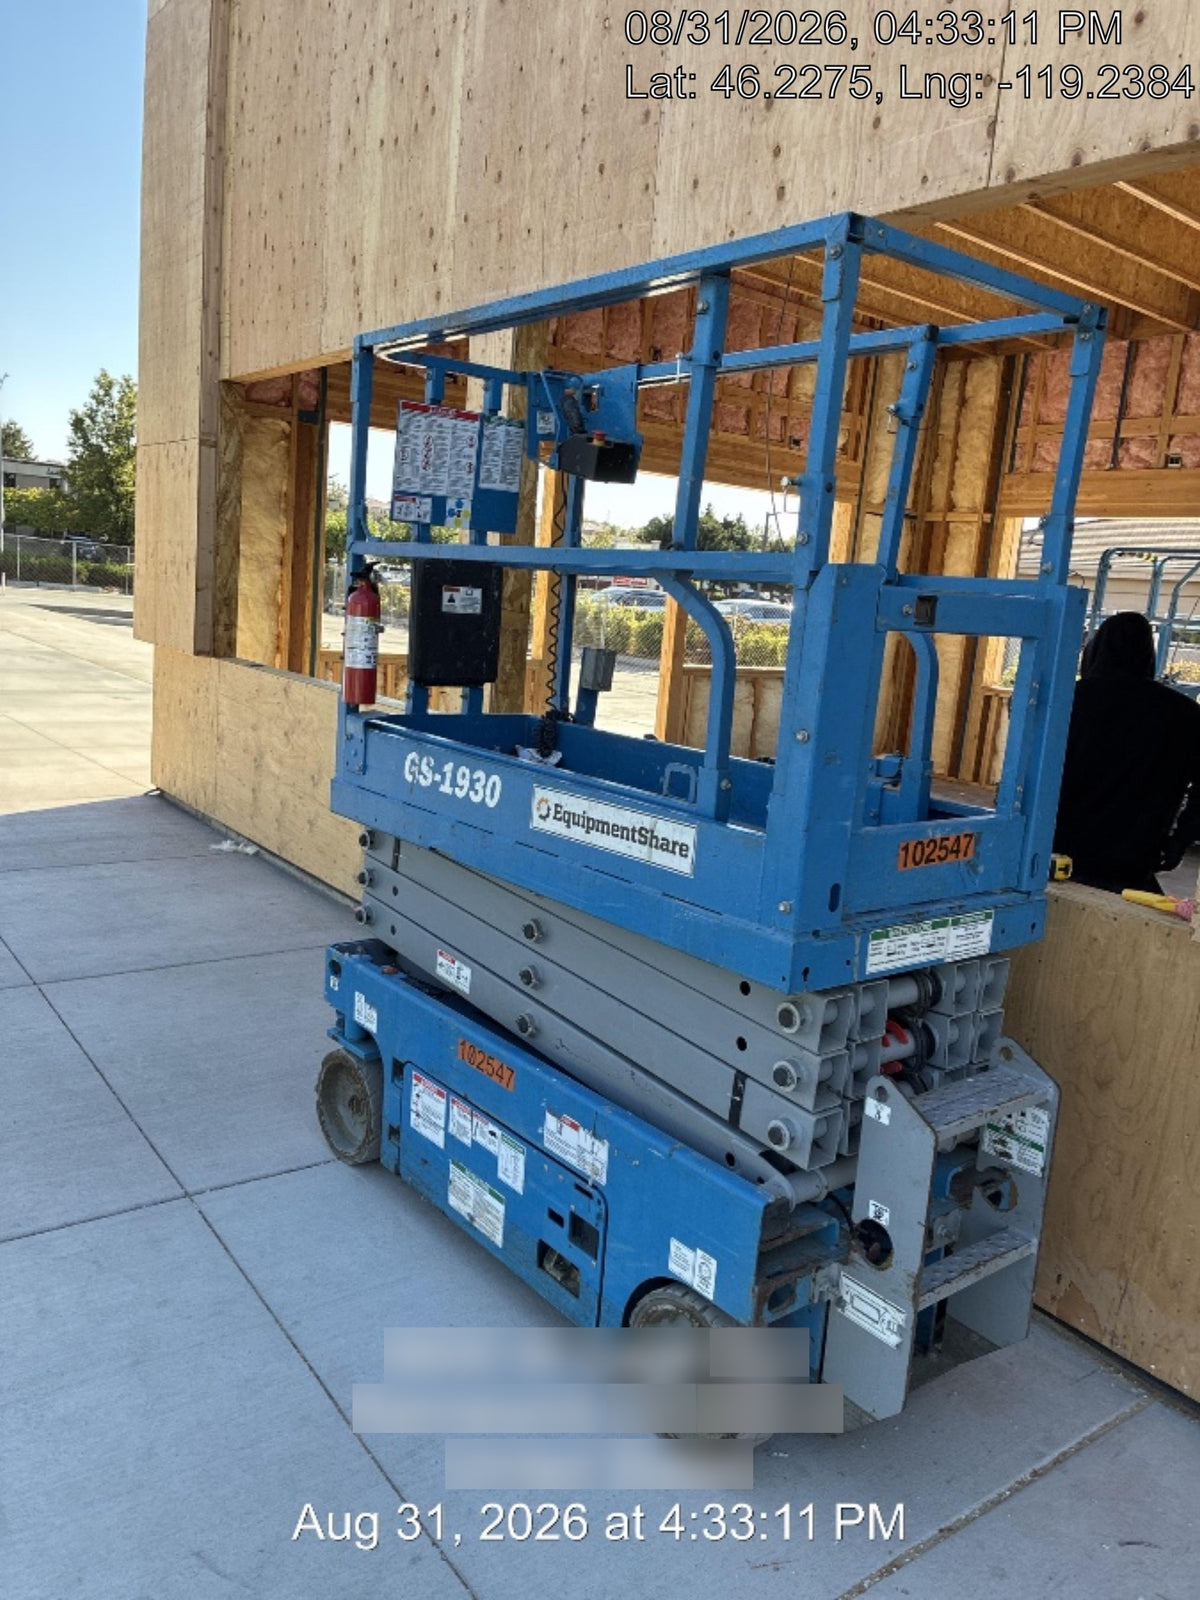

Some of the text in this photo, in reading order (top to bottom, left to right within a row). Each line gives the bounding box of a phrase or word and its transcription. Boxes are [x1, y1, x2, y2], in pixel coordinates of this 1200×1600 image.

[404, 751, 502, 809] GS-1930
[552, 803, 690, 859] EquipmentShare
[900, 833, 975, 868] 102547
[460, 1039, 515, 1089] 102547
